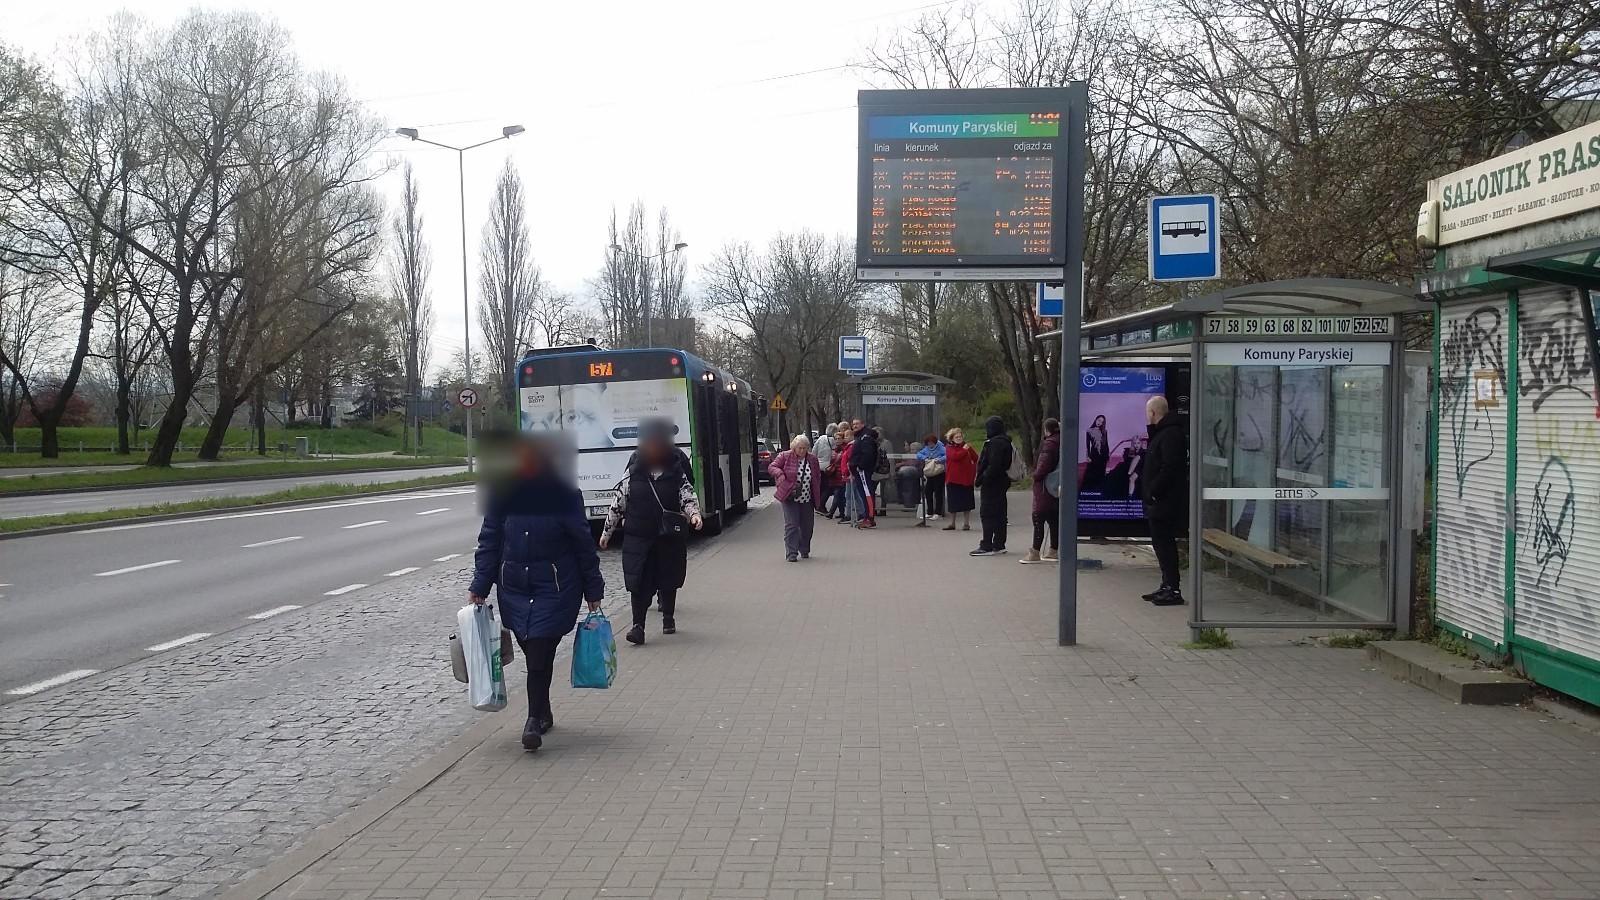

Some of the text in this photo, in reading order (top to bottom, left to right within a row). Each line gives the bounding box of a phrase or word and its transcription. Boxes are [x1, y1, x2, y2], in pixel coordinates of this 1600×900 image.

[909, 121, 1018, 136] Komuny Paryskiej
[874, 143, 890, 153] linia
[905, 143, 939, 153] kierunek
[1013, 142, 1052, 152] odjazd za
[1443, 159, 1531, 212] SALONIK
[1441, 222, 1457, 232] PRASA
[1460, 213, 1488, 228] PAPIEROSY
[1492, 206, 1513, 219] BILETY
[1517, 197, 1546, 213] ZABAWKI
[1209, 318, 1388, 333] 57 58 59 63 68 82 101 107 522 524
[1244, 348, 1353, 363] Komuny Paryskiej
[1275, 489, 1303, 498] ams
